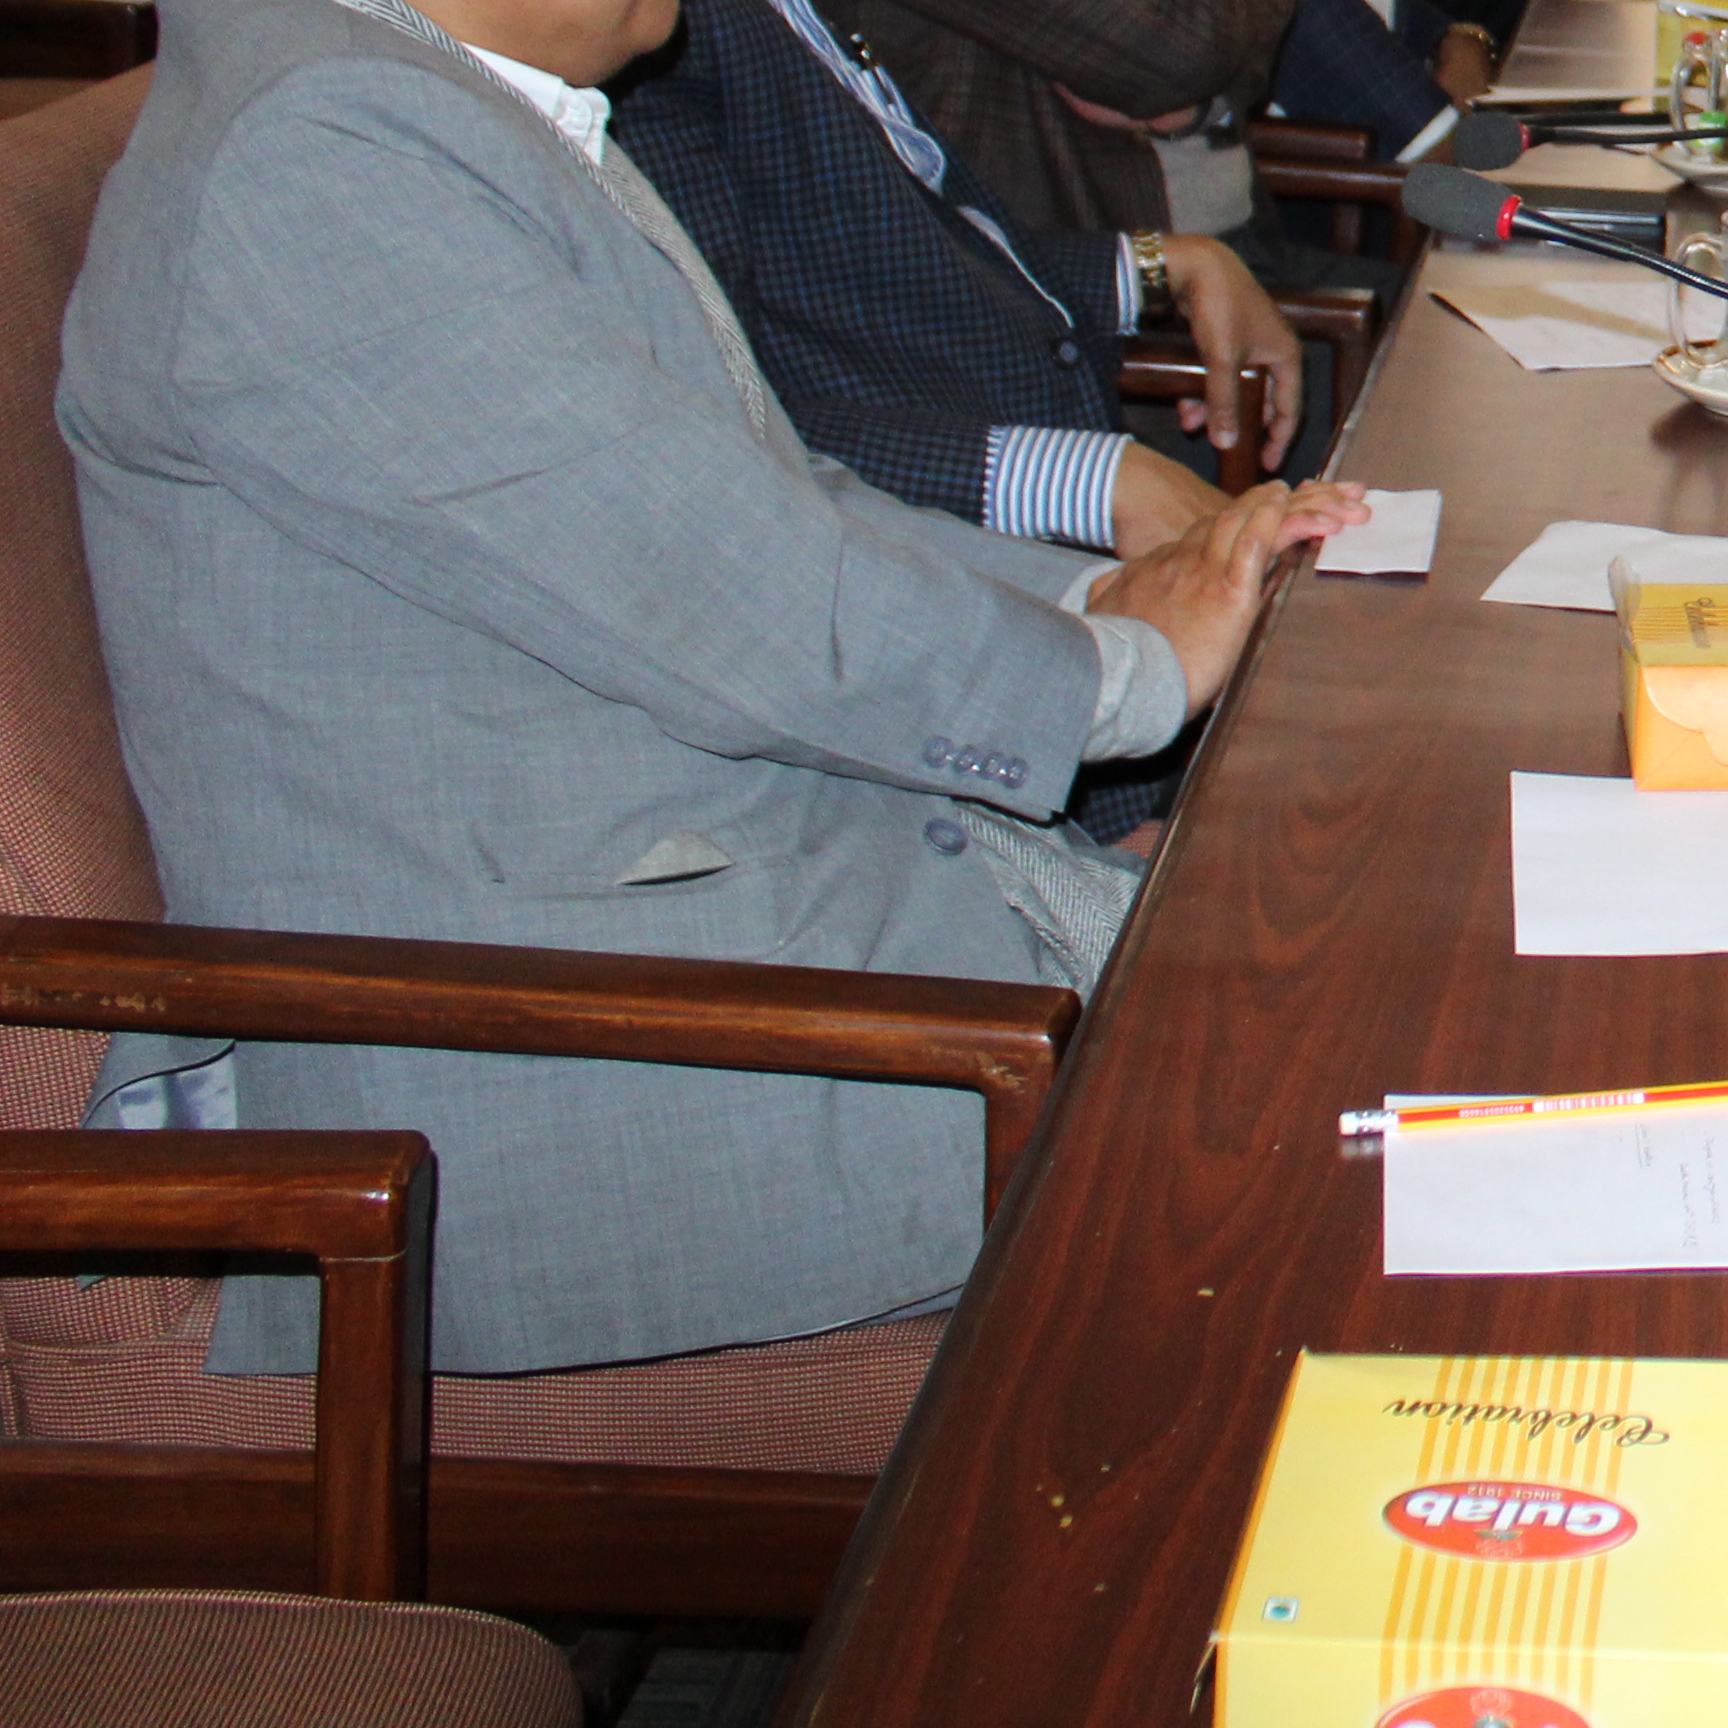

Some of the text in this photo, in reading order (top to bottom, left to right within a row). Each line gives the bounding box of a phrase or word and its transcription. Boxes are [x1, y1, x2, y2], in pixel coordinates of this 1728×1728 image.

[1381, 1399, 1669, 1448] Celebration
[1404, 1492, 1621, 1536] Gulab
[1467, 1484, 1562, 1501] SINCE 1912
